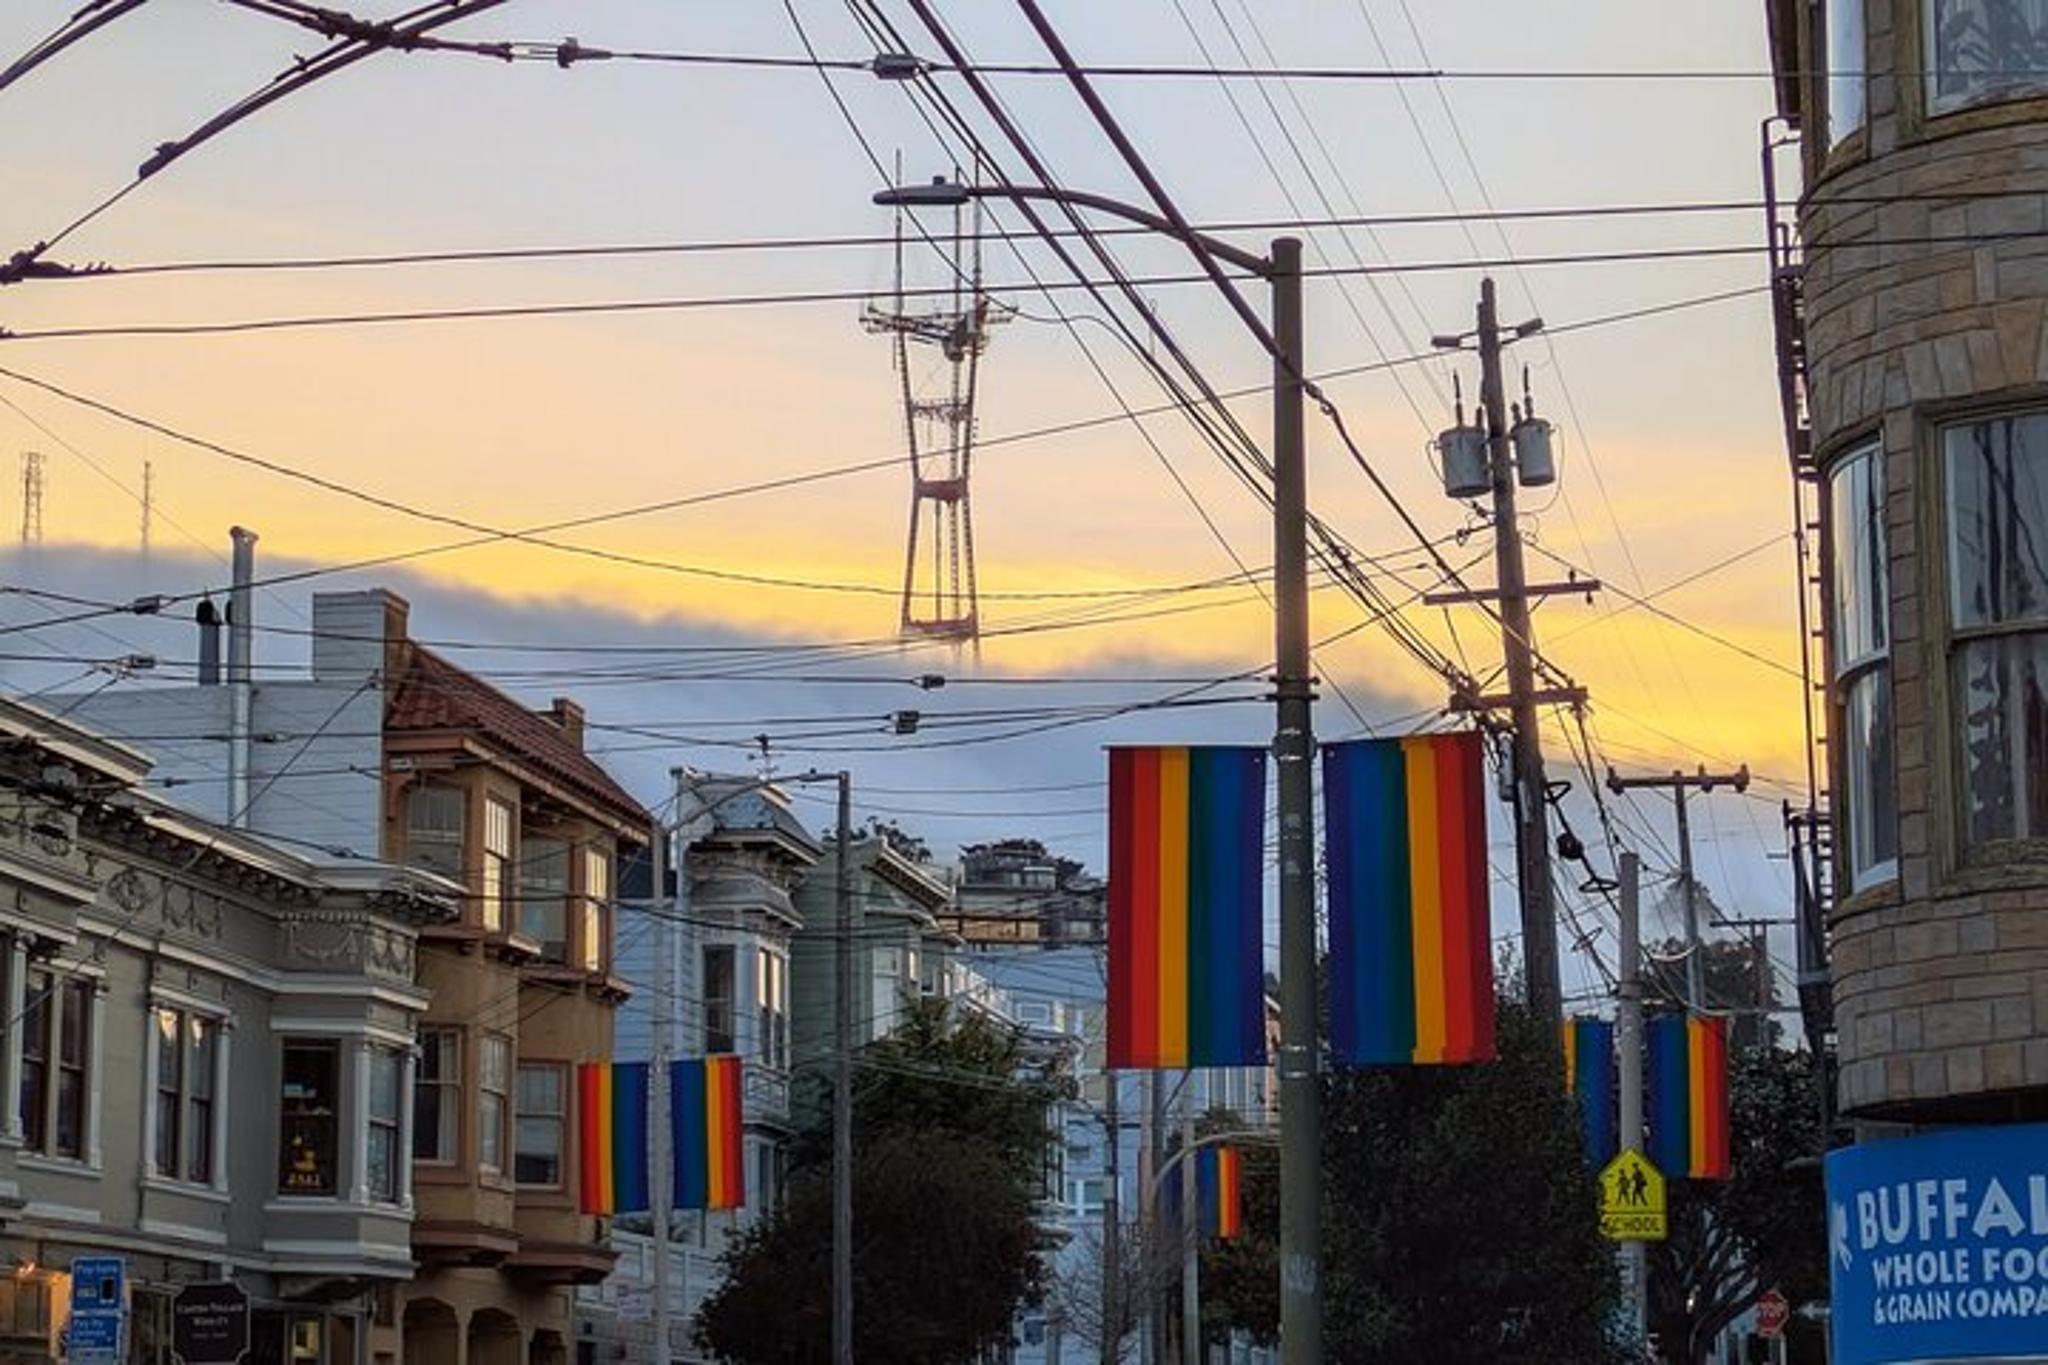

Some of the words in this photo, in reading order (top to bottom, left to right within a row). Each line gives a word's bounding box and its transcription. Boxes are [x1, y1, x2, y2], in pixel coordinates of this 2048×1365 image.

[1603, 1216, 1662, 1232] SCHOOL
[1856, 1174, 2048, 1249] BUFFAL
[1871, 1248, 1970, 1290] WHOLE
